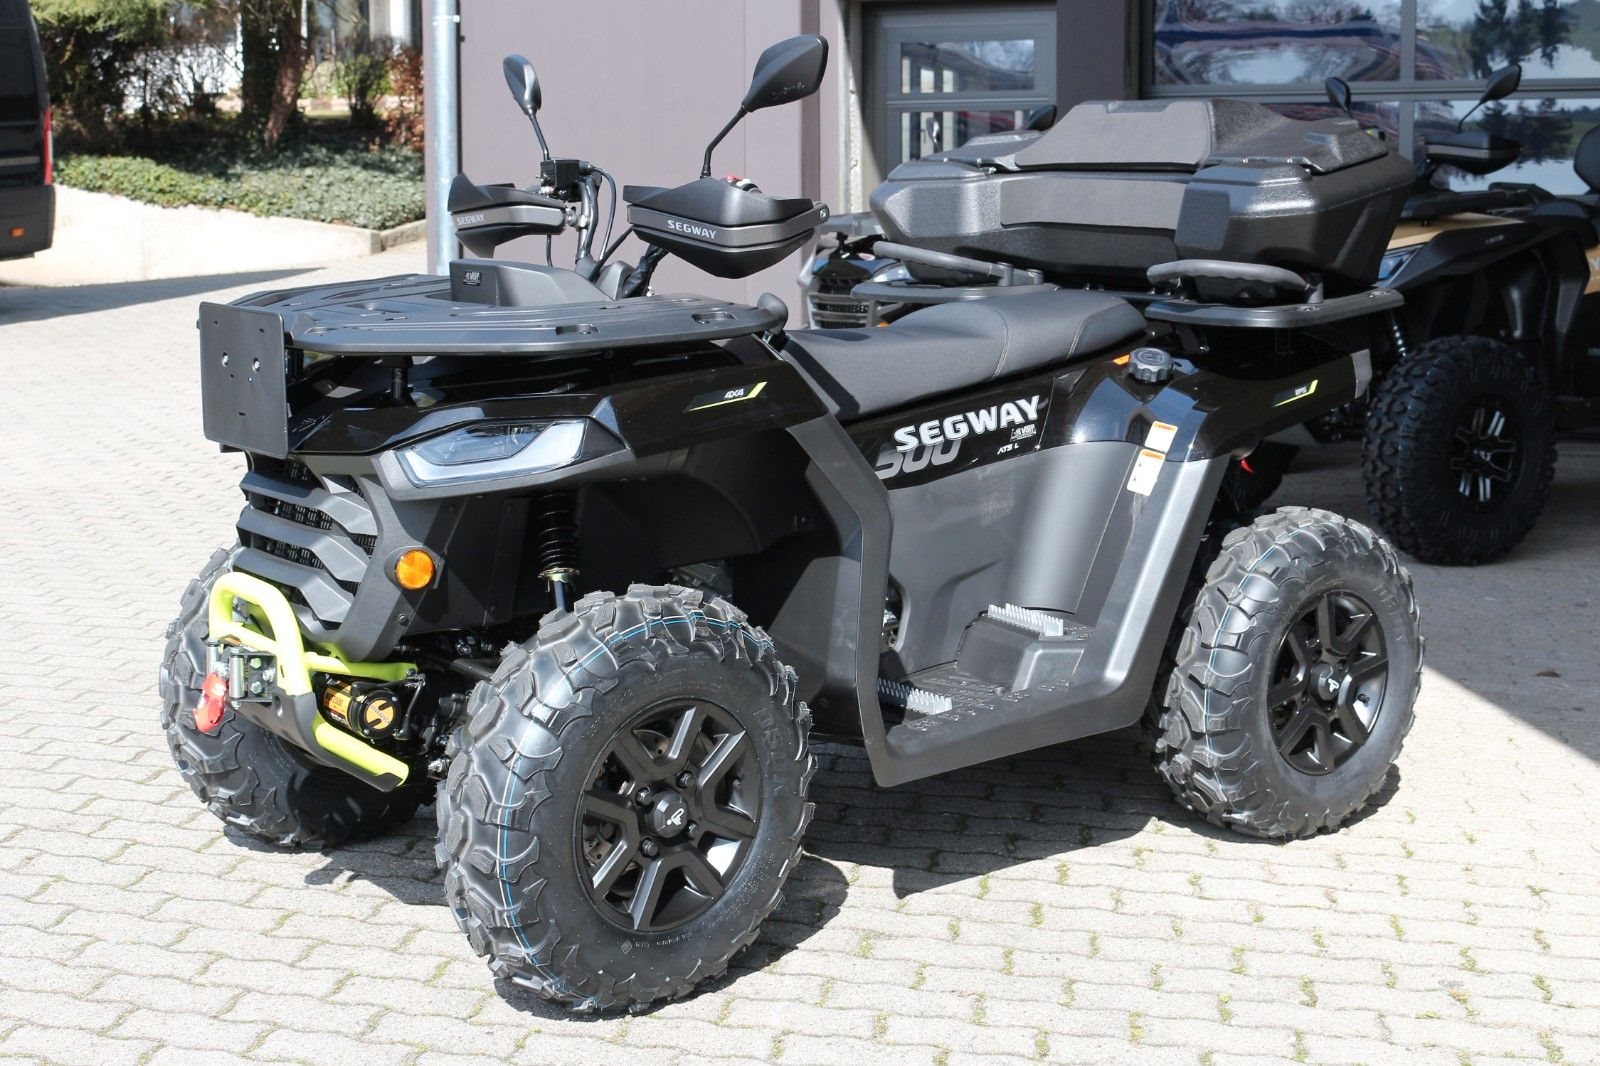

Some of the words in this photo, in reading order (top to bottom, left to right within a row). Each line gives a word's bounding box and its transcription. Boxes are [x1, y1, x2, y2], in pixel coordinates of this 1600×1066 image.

[456, 213, 485, 226] SEGWAY
[667, 219, 717, 240] SEGWAY
[893, 395, 1040, 453] SEGWAY
